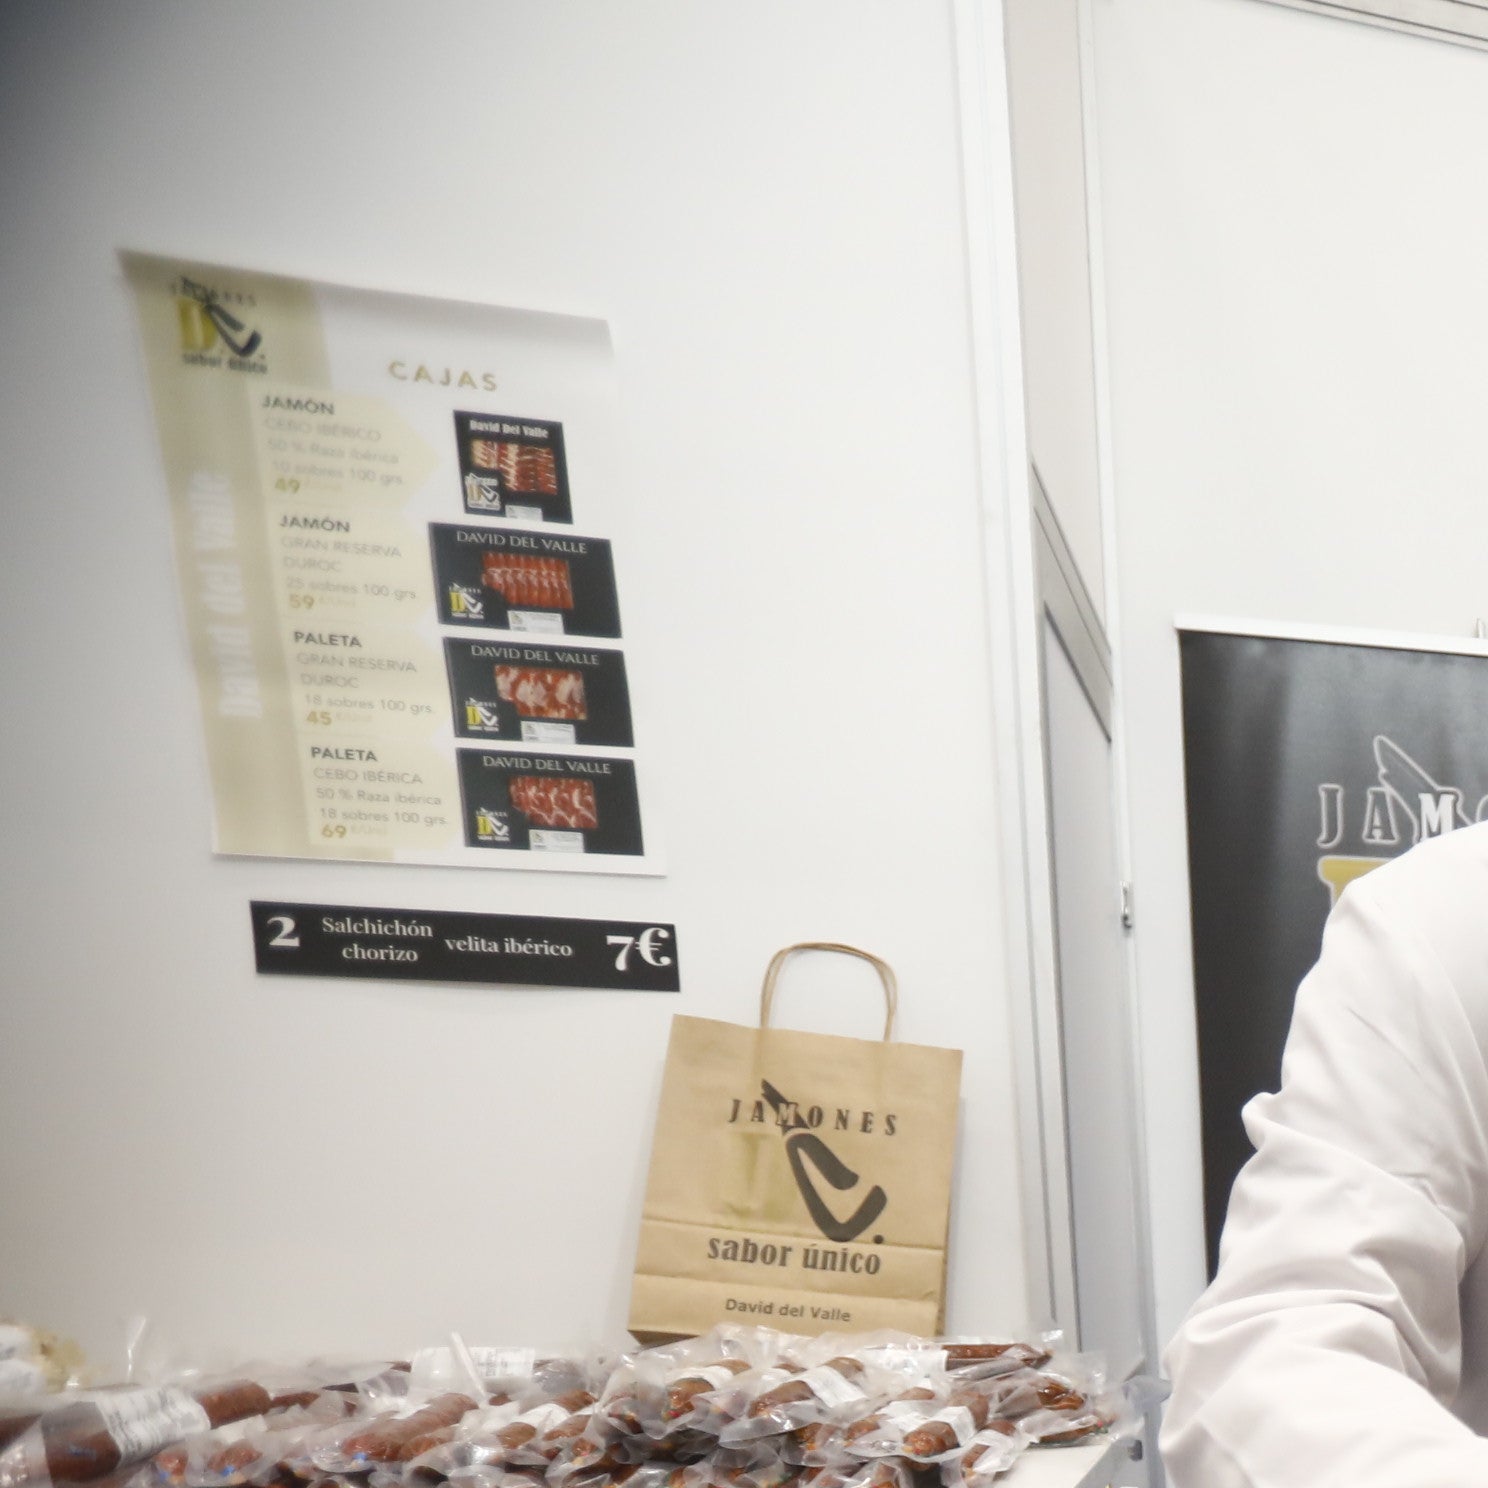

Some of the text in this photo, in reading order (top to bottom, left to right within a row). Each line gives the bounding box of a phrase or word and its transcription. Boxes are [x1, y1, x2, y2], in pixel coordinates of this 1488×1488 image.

[388, 360, 497, 392] CAJAS
[274, 477, 301, 494] 49
[279, 514, 351, 533] JAMÓN
[280, 536, 402, 558] GRAN RESERVA
[456, 530, 588, 554] DAVID DEL VALLE
[308, 580, 359, 595] sobres
[363, 583, 389, 597] 100
[289, 593, 315, 610] 59
[294, 631, 362, 648] PALETA
[297, 652, 417, 672] GRAN RESERVA
[470, 645, 600, 666] DAVID DEL VALLE
[300, 673, 360, 689] DUROC
[327, 695, 375, 710] sobres
[380, 698, 405, 712] 100
[306, 710, 332, 726] 45
[311, 746, 378, 762] PALETA
[483, 755, 612, 774] DAVID DEL VALLE
[313, 766, 423, 785] CEBO IBÉRICA
[357, 790, 390, 804] Raza
[320, 807, 337, 819] 18
[342, 809, 389, 823] sobres
[394, 811, 420, 825] 100
[321, 824, 347, 838] 69
[267, 916, 300, 947] 2
[322, 917, 433, 938] Salchichón
[342, 942, 419, 963] chorizo
[445, 935, 573, 958] velita ibérico
[605, 927, 672, 971] 7€
[729, 1098, 897, 1137] JAMONES
[707, 1237, 881, 1275] sabor único
[725, 1298, 851, 1322] David del Valle
